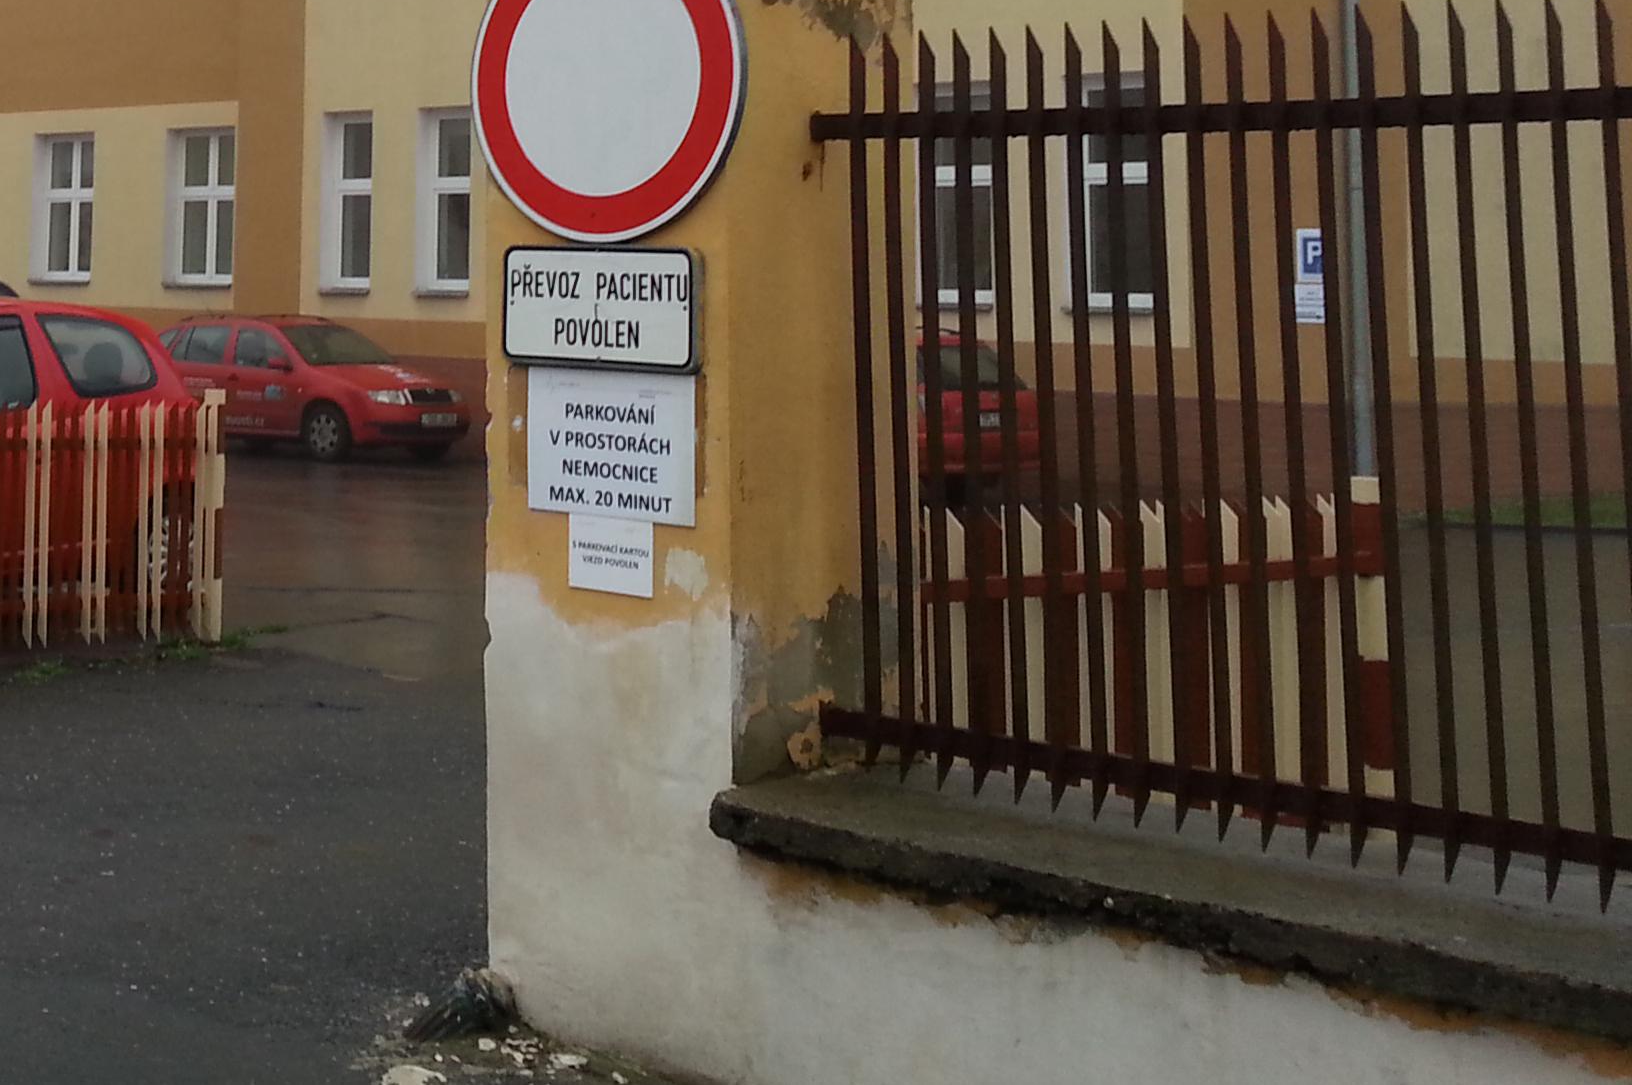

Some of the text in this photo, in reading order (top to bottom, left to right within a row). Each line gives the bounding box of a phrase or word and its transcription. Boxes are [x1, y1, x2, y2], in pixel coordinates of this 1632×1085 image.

[1307, 240, 1322, 264] P
[510, 264, 688, 303] PŘEVOZ PACIENTU
[553, 317, 640, 349] POVOLEN
[564, 402, 656, 426] PARKOVÁNÍ
[549, 429, 671, 456] V PROSTORÁCH
[561, 458, 658, 484] NEMOCNICE
[549, 485, 672, 514] MAX. 20 MINUT
